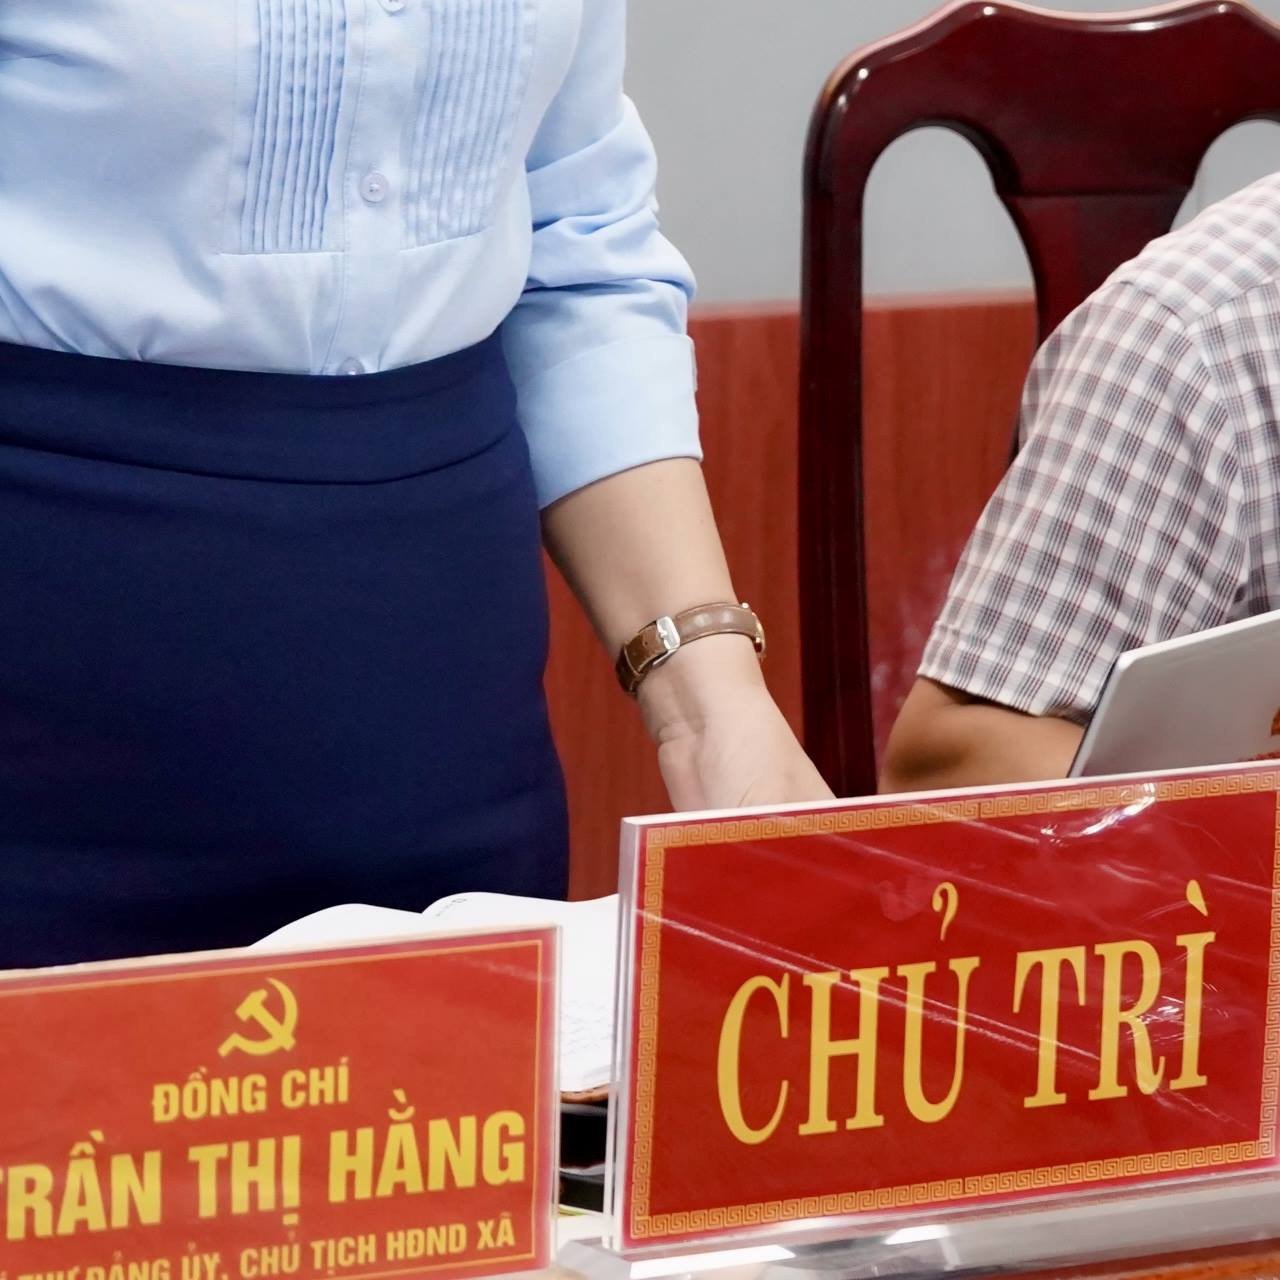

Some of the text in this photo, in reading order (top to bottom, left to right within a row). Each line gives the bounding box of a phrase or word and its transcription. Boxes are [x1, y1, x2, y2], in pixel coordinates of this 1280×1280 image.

[716, 878, 1217, 1146] CHỦ TRÌ
[151, 1056, 350, 1124] ĐỒNG CHÍ
[187, 1134, 303, 1227] THỊ
[327, 1087, 527, 1204] HẰNG
[239, 1229, 301, 1279] CHỦ
[310, 1231, 377, 1276] TỊCH
[386, 1222, 468, 1261] HĐND
[476, 1211, 516, 1251] XÃ
